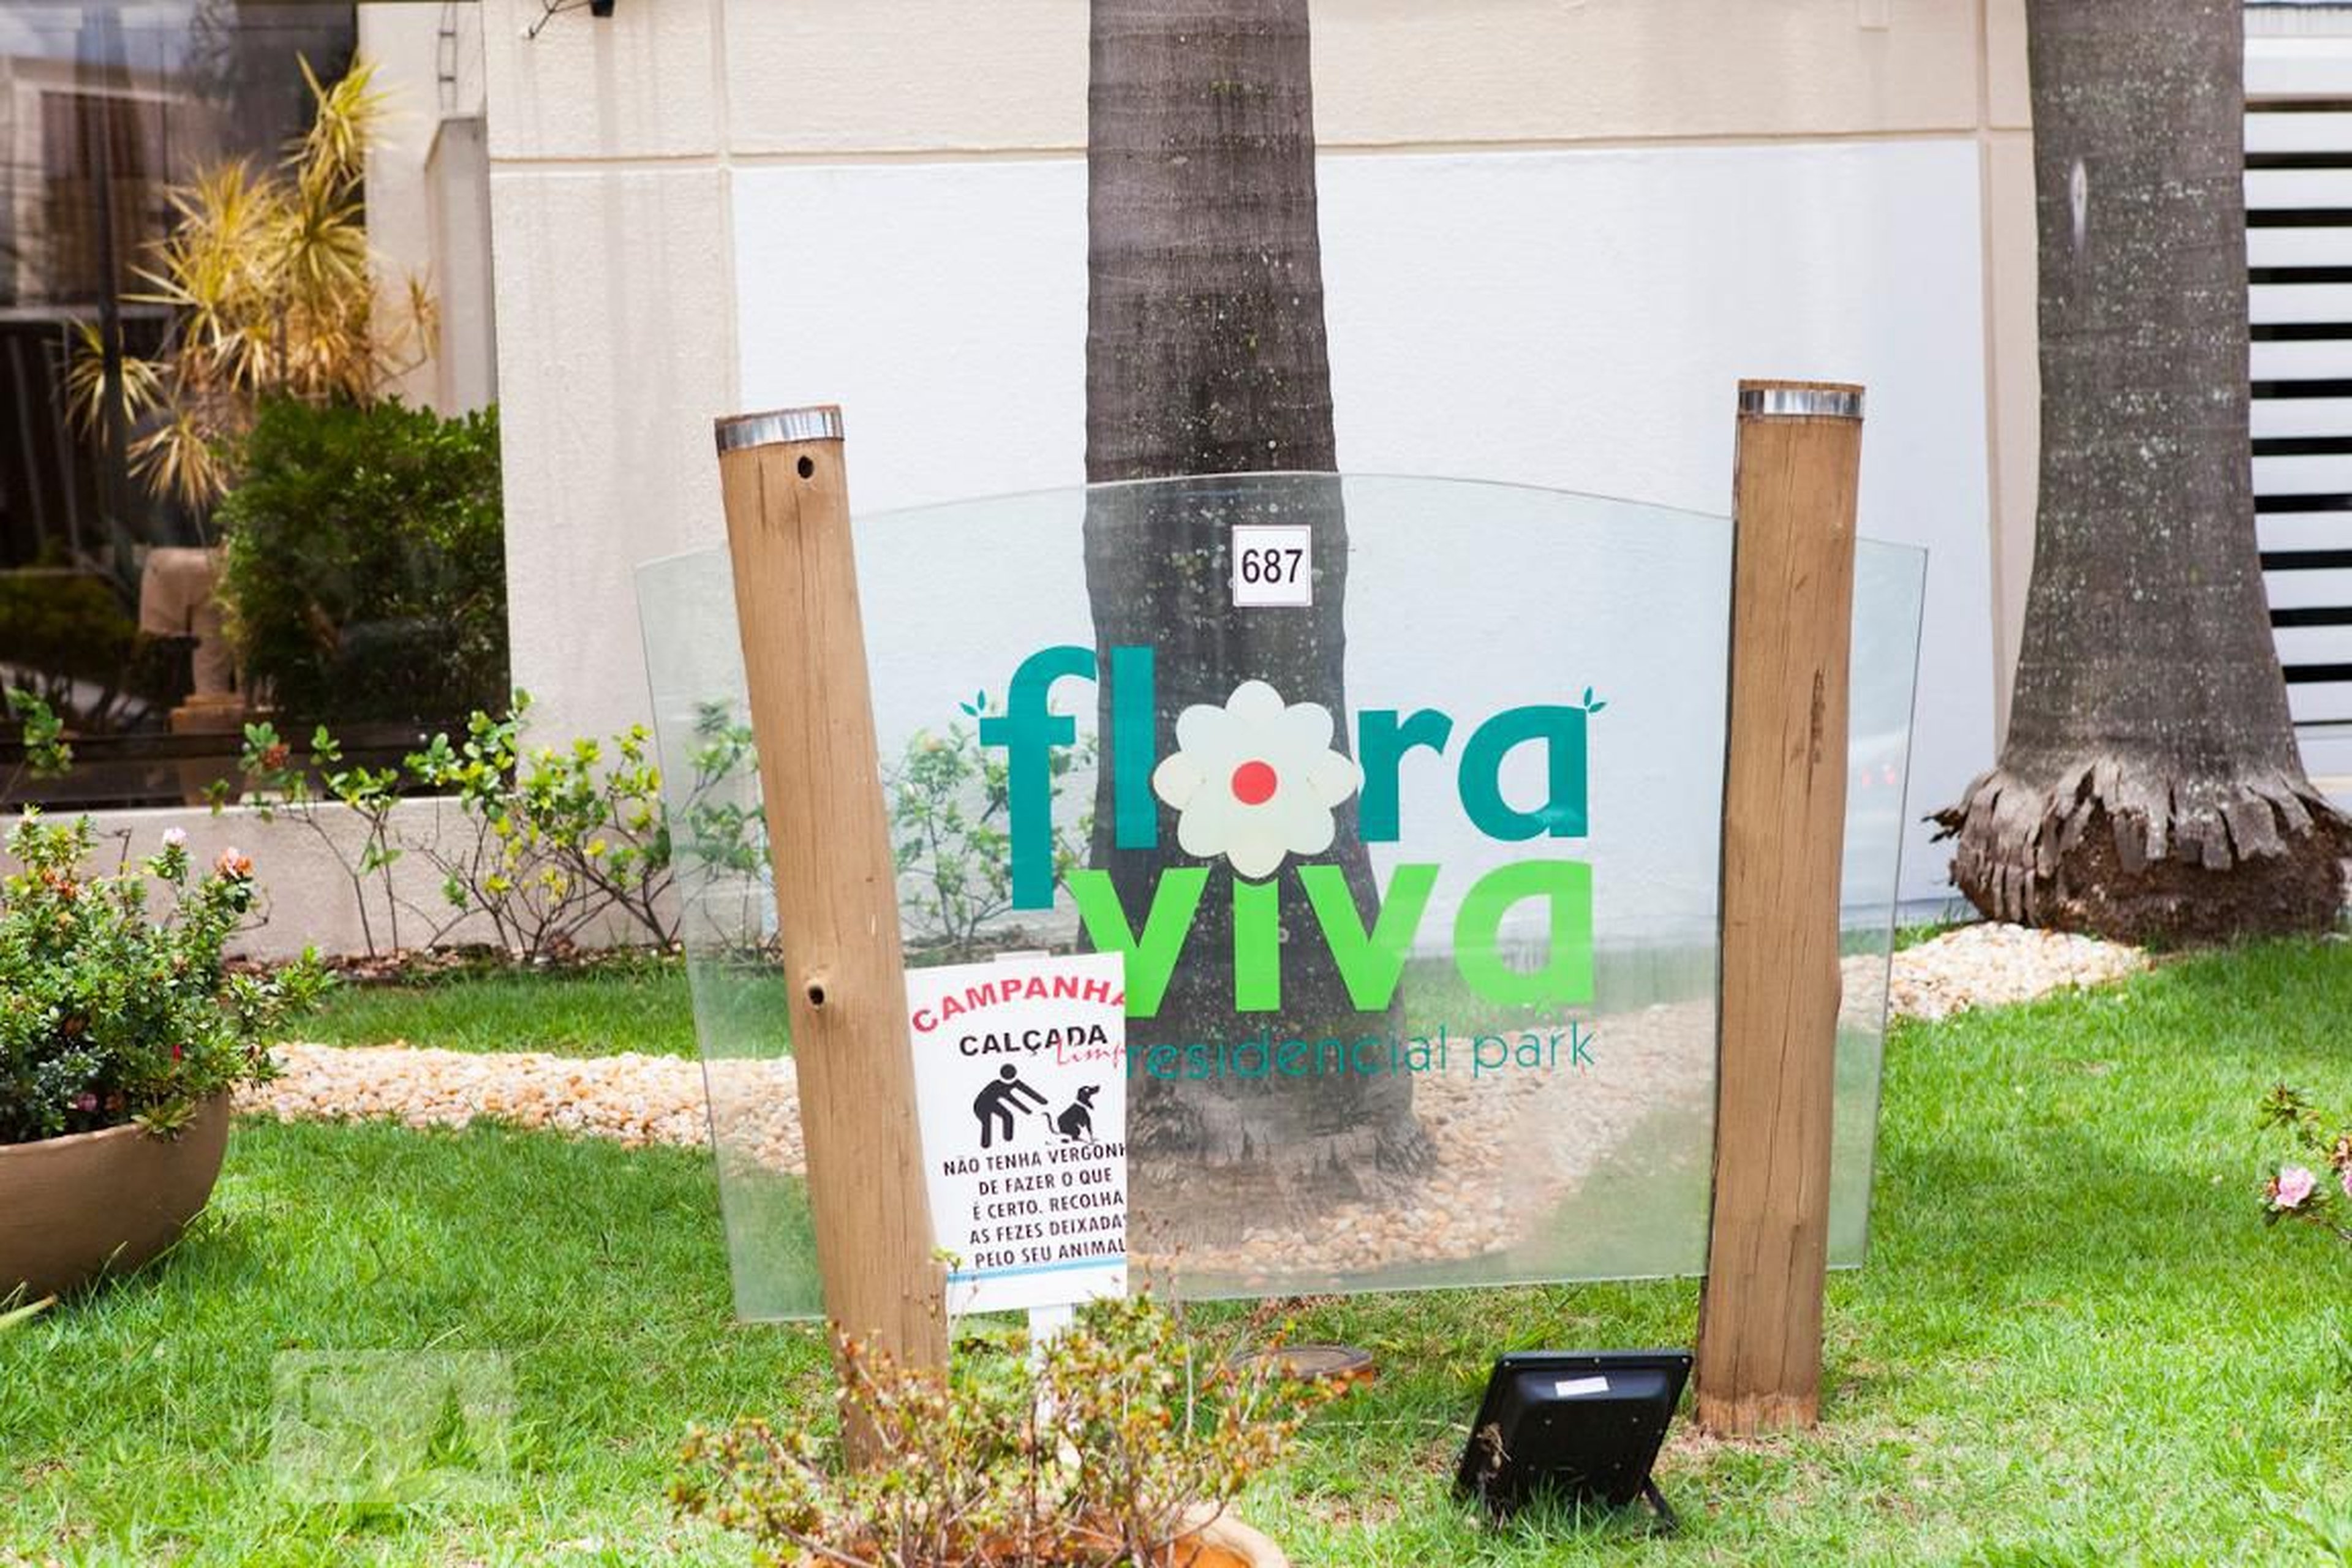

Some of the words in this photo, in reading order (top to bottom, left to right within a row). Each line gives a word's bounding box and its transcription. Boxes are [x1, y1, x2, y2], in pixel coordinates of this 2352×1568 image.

[1242, 549, 1303, 584] 687
[1067, 860, 1592, 1017] viva
[959, 1024, 1107, 1056] CALÇADA
[1473, 1021, 1595, 1078] park
[944, 1156, 980, 1177] NÃO
[986, 1152, 1041, 1172] TENHA
[979, 1180, 998, 1196] DE
[1005, 1174, 1055, 1193] FAZER
[1061, 1172, 1072, 1187] O
[1079, 1167, 1112, 1186] QUE
[973, 1202, 981, 1221] É
[987, 1199, 1043, 1219] CERTO.
[1050, 1189, 1125, 1212] RECOLHA
[970, 1227, 990, 1245] AS
[996, 1223, 1043, 1242] FEZES
[974, 1250, 1016, 1269] PELO
[1021, 1245, 1052, 1264] SEU
[1058, 1237, 1126, 1259] ANIMAL
